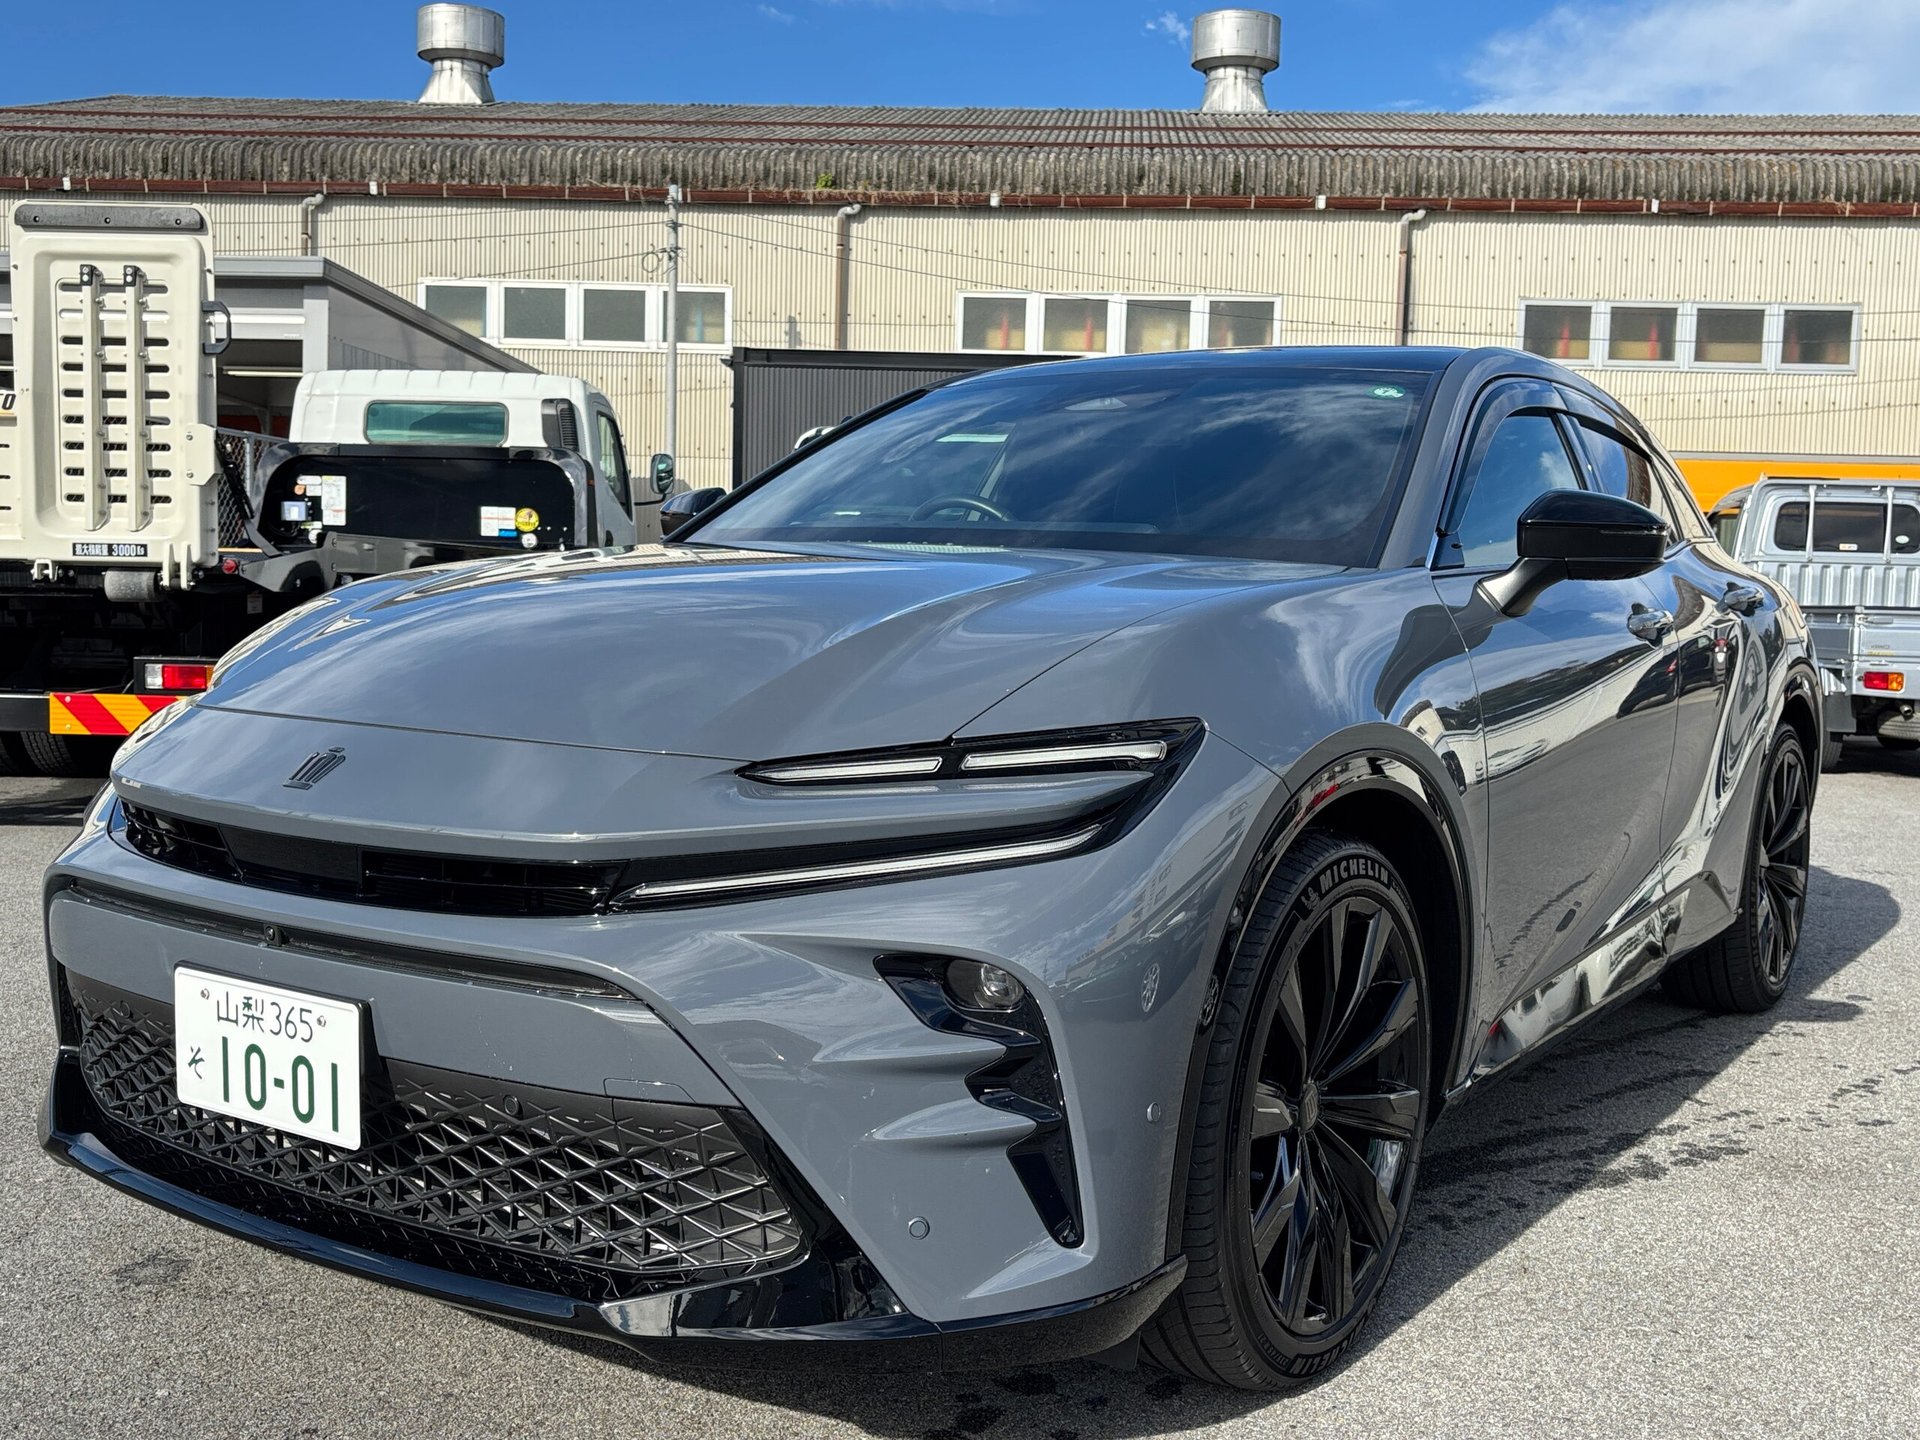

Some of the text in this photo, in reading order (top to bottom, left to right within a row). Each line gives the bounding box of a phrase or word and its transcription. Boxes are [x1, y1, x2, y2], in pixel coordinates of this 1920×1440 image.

[1319, 858, 1389, 895] MICHELIN
[188, 1036, 339, 1133] そ 10-01
